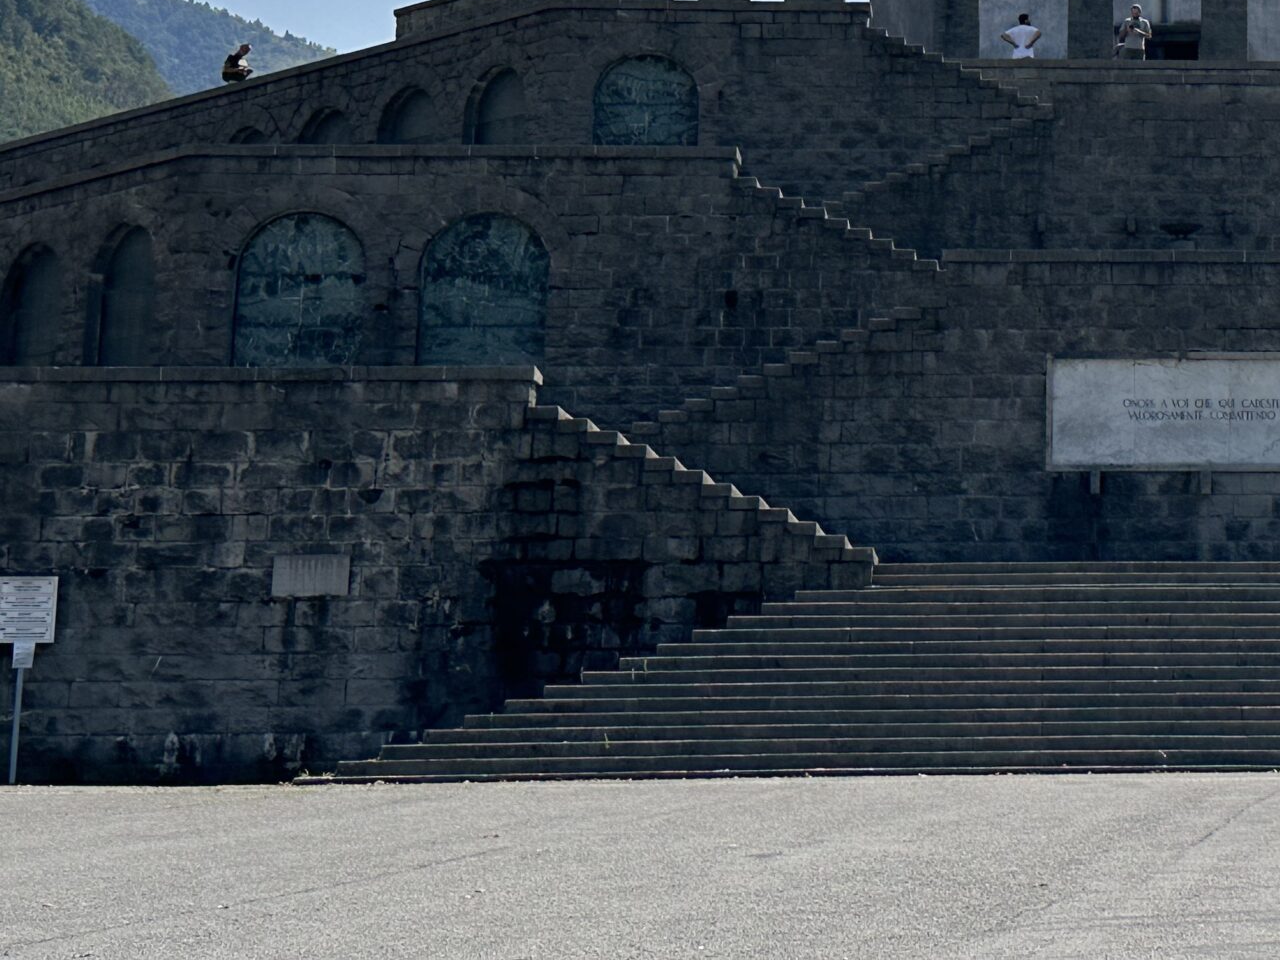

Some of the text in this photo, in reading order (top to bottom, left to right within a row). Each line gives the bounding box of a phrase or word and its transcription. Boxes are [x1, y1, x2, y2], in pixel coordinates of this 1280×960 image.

[1161, 399, 1168, 409] A
[1171, 398, 1189, 409] VOI
[1195, 398, 1212, 409] CHE
[1218, 398, 1235, 409] QUI
[1241, 398, 1280, 409] CADESTE
[1128, 410, 1276, 421] VALOROSAMENTE COMBATTENDO
